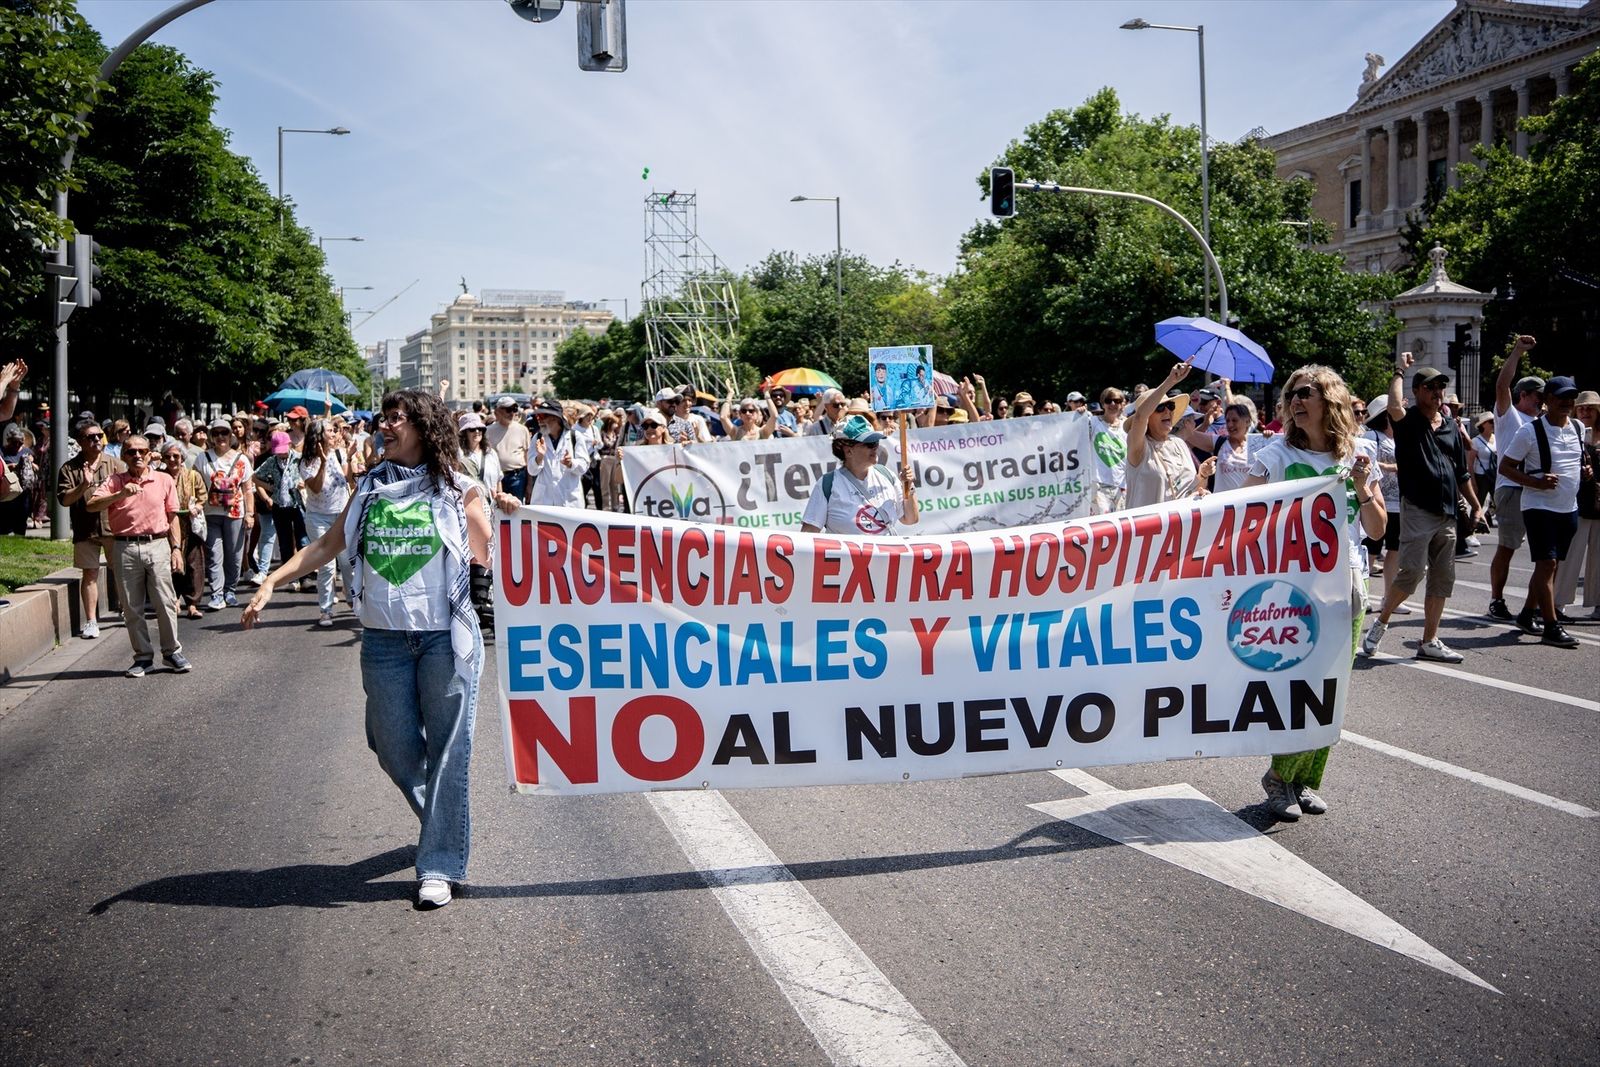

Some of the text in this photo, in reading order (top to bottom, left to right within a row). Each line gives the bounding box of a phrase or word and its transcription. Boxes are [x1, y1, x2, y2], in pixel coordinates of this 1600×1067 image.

[958, 434, 1004, 449] BOICOT
[963, 445, 1080, 491] gracias
[738, 516, 770, 528] QUE
[772, 512, 803, 526] TUS
[937, 496, 960, 510] NO
[965, 491, 1005, 507] SEAN
[1009, 487, 1035, 502] SUS
[1039, 481, 1082, 498] BALAS
[366, 522, 435, 538] Sanidad
[500, 492, 1340, 606] URGENCIAS EXTRA HOSPITALARIAS
[1231, 602, 1312, 624] Plataforma
[1240, 626, 1299, 646] SAR
[507, 596, 1203, 692] ESENCIALES Y VITALES
[509, 677, 1338, 785] NO AL NUEVO PLAN
